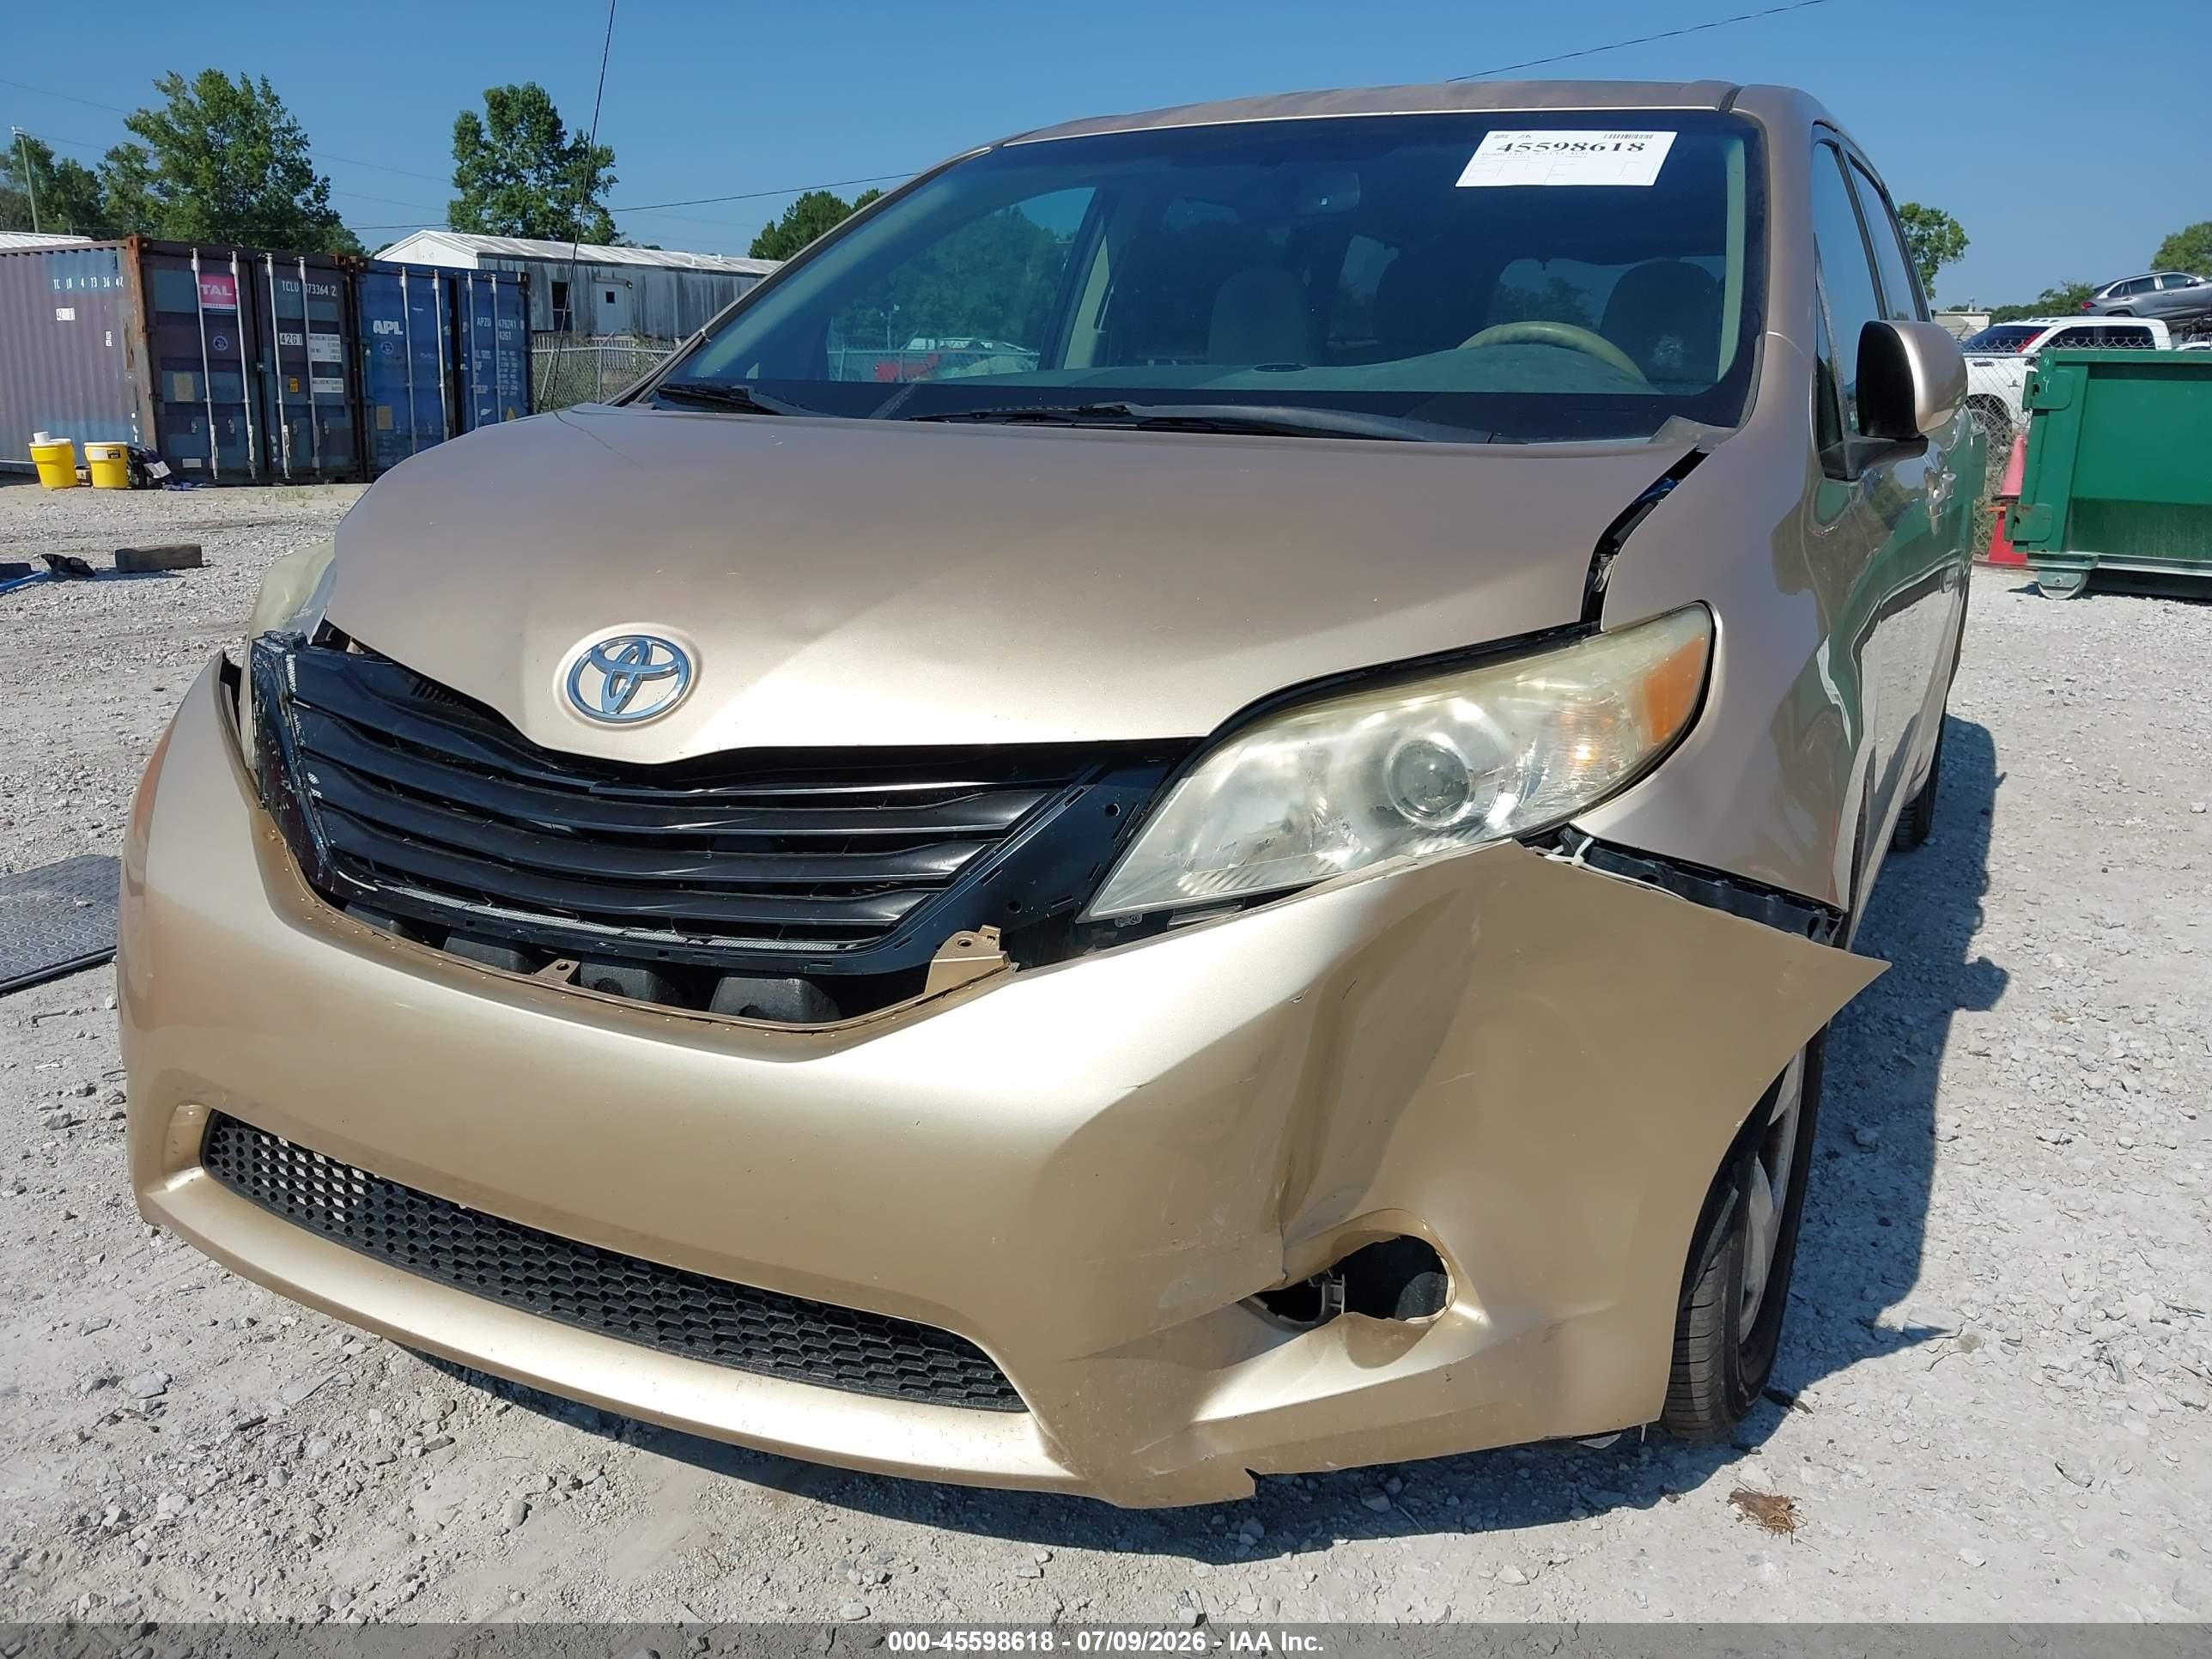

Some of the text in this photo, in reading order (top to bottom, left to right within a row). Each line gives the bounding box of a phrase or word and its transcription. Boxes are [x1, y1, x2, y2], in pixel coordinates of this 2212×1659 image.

[1497, 142, 1645, 152] 45598618
[199, 284, 233, 296] TAL
[373, 320, 404, 335] APL
[281, 334, 301, 344] 42G1
